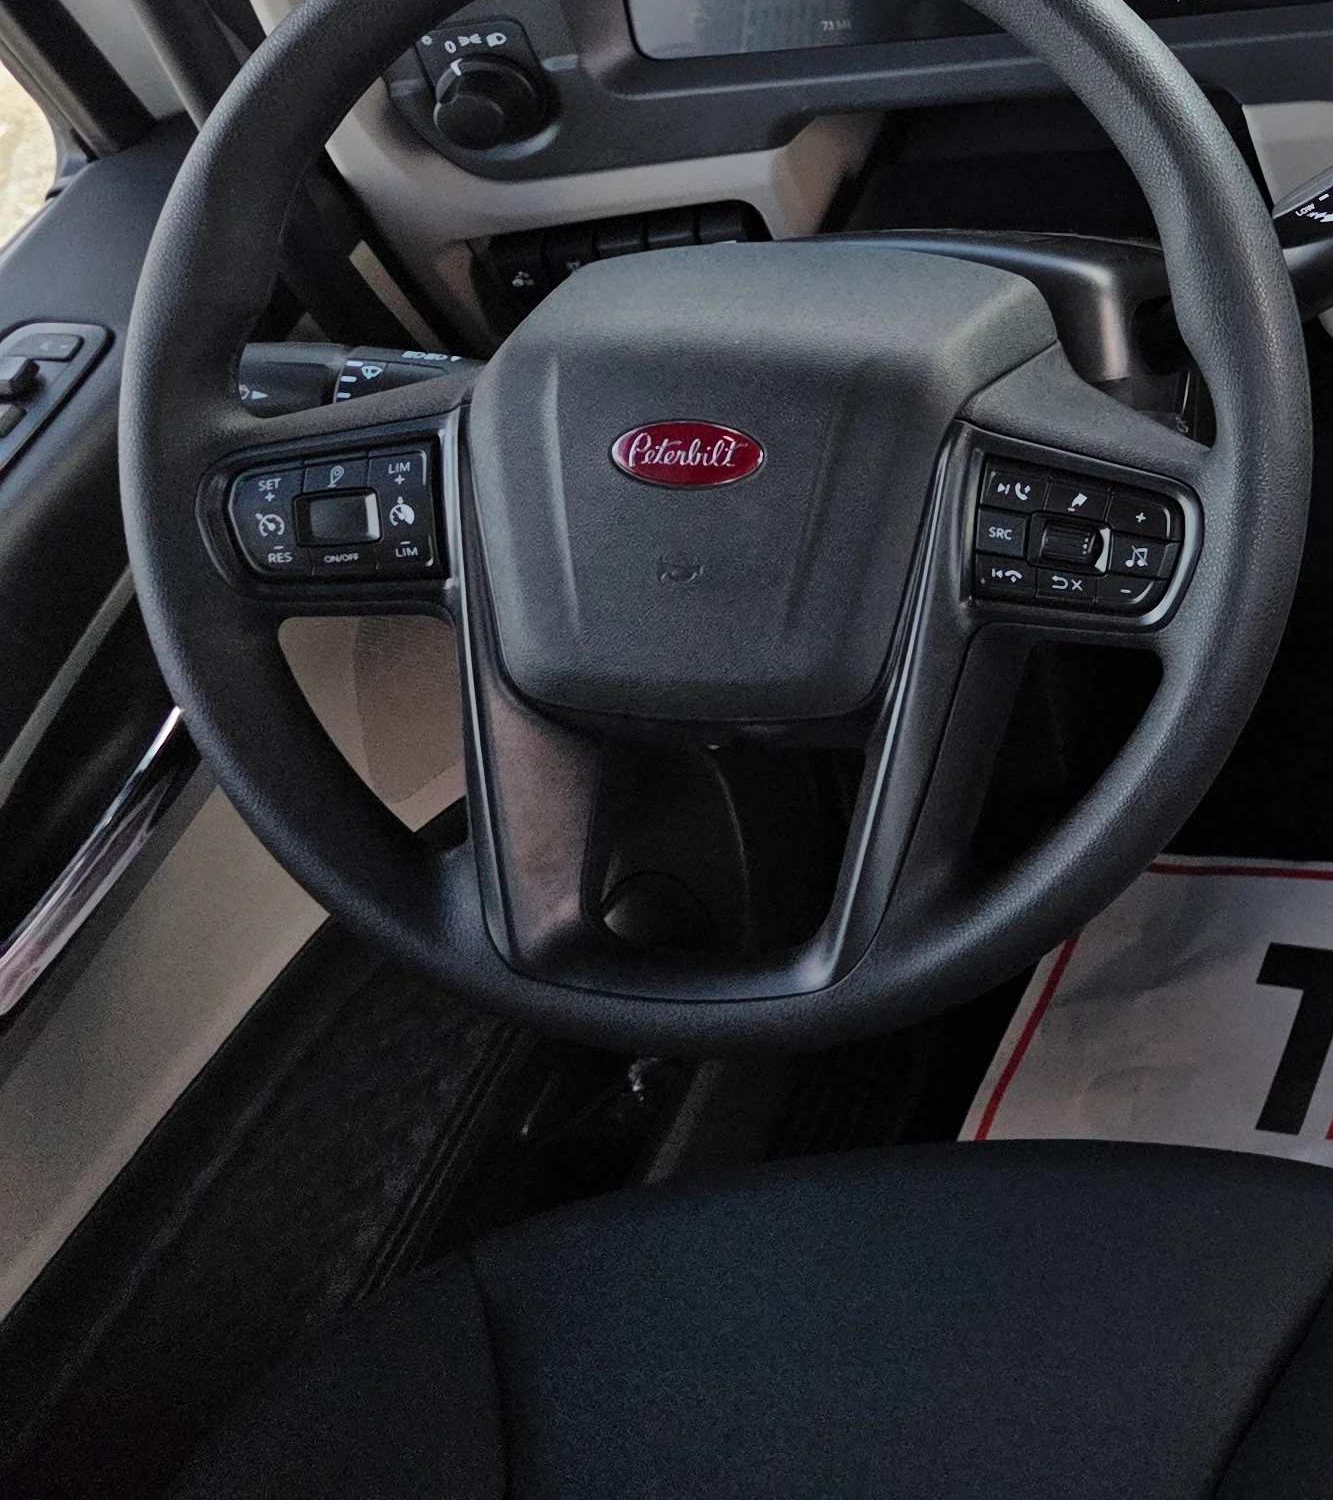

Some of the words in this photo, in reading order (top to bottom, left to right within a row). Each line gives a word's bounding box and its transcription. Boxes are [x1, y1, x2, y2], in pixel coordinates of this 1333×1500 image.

[1295, 202, 1316, 217] LOW
[628, 432, 749, 468] Peterbilt
[387, 461, 412, 475] LIM
[257, 478, 282, 491] SET
[988, 526, 1013, 541] SRC
[267, 552, 293, 564] RES
[323, 553, 360, 563] ON/OFF
[395, 546, 419, 558] LIM
